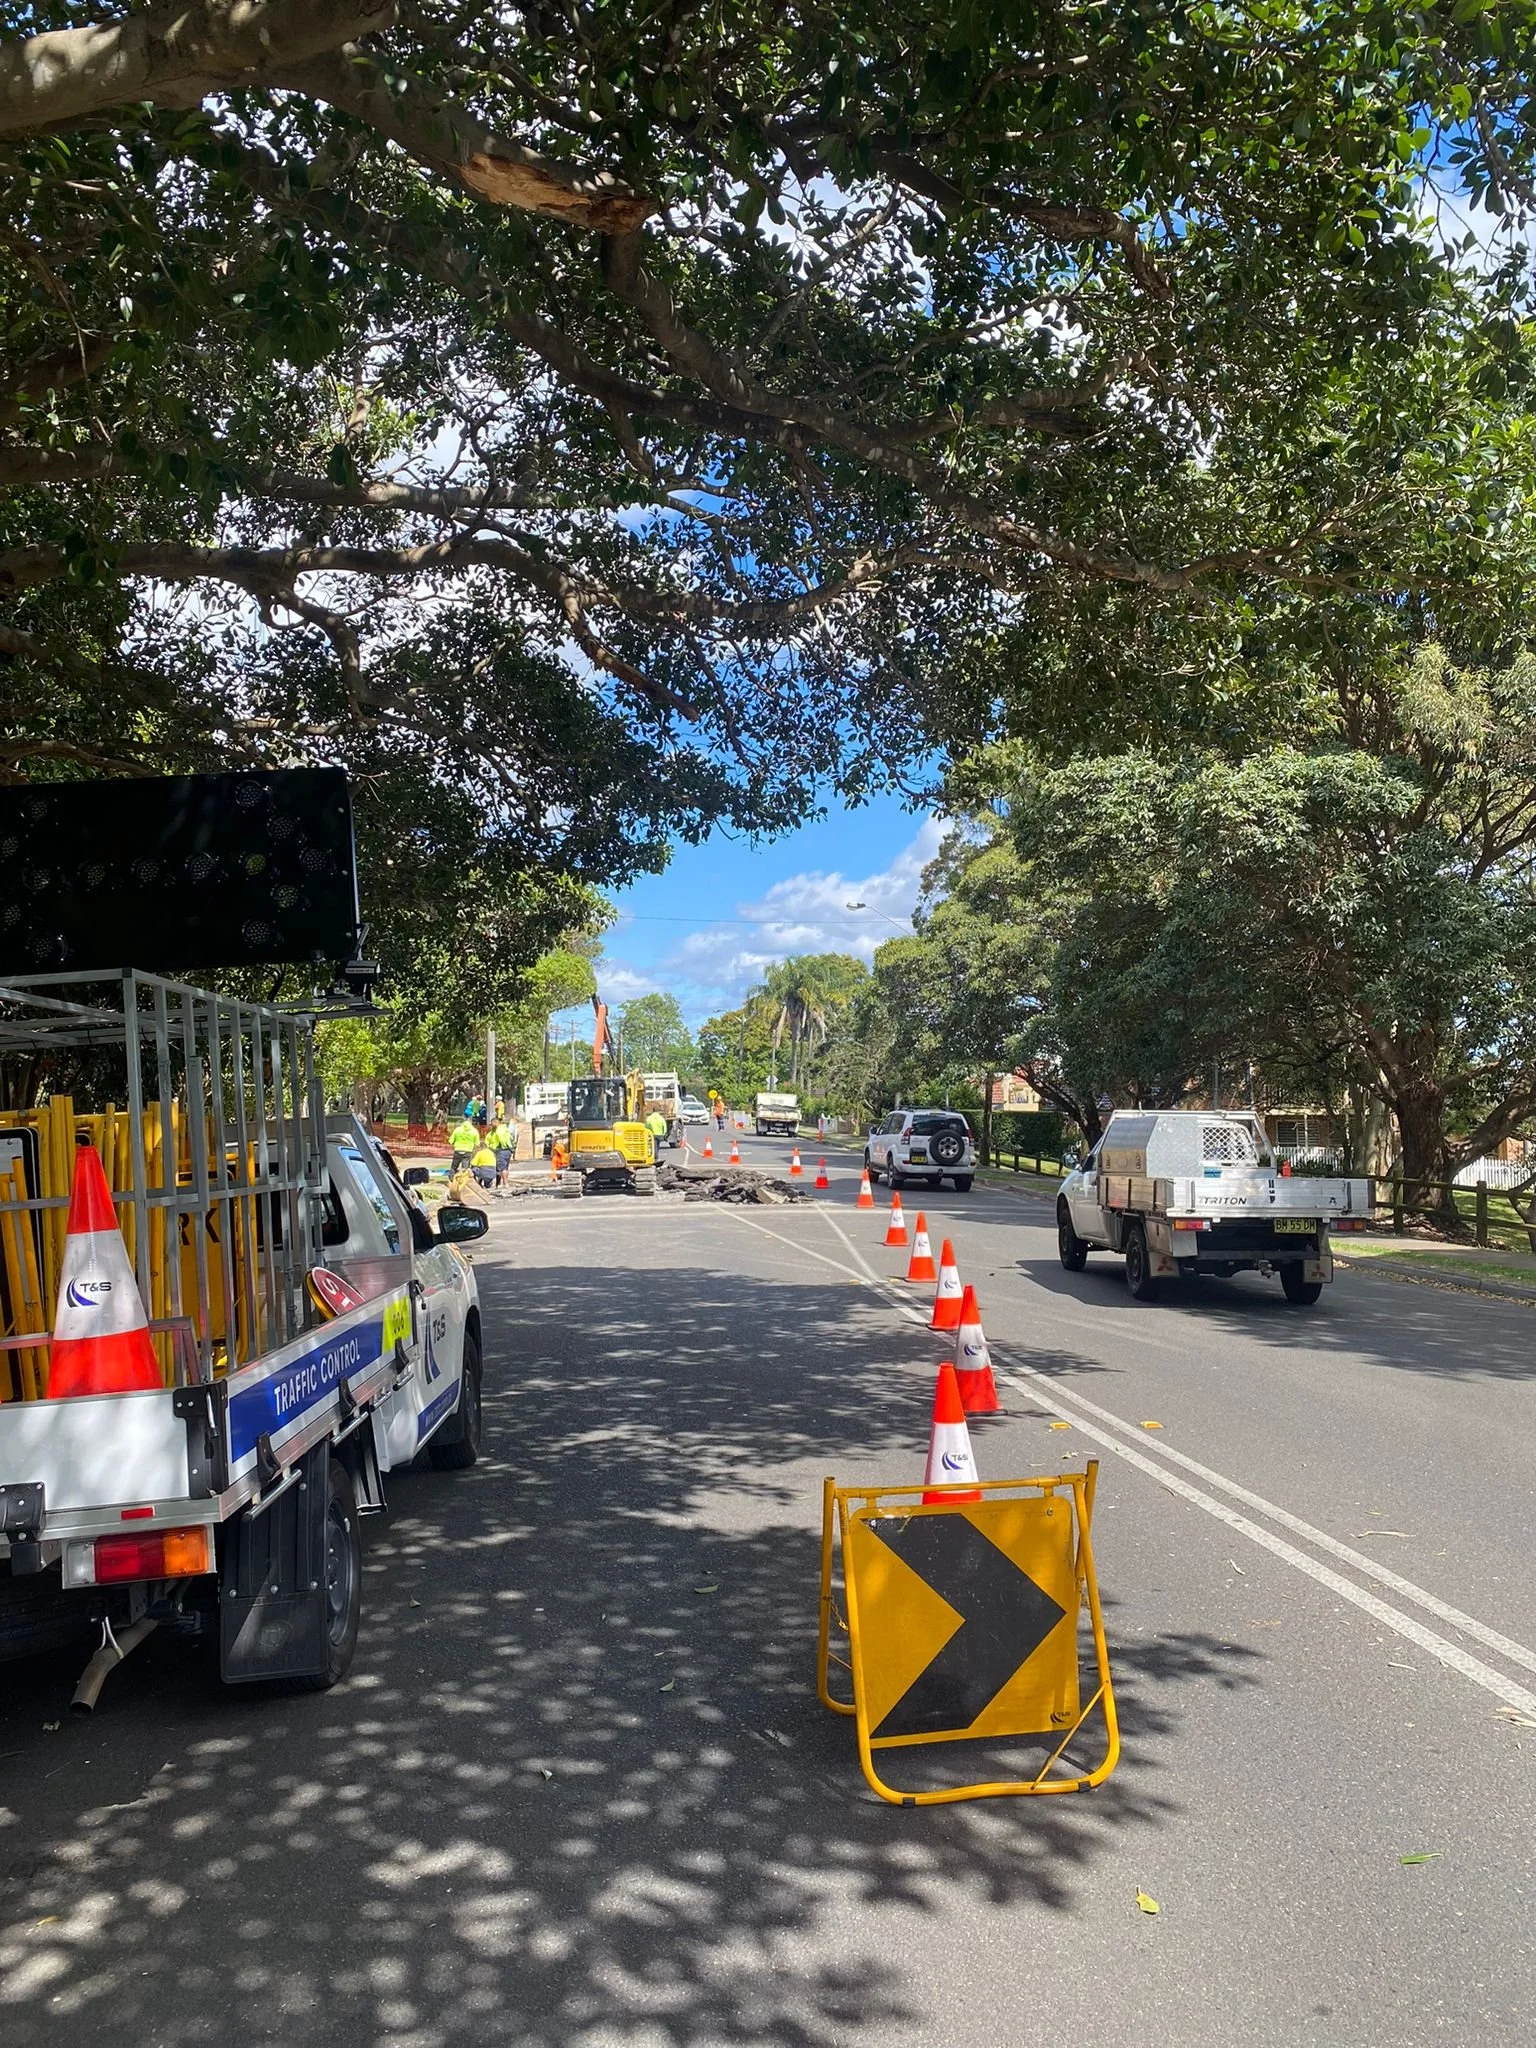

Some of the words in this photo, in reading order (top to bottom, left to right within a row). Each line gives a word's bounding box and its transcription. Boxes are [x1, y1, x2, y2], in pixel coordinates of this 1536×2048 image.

[1204, 1197, 1247, 1205] TRITON
[80, 1281, 112, 1292] T&S
[432, 1313, 446, 1344] T&S
[274, 1364, 318, 1416] TRAFFIC
[320, 1338, 360, 1384] CONTROL
